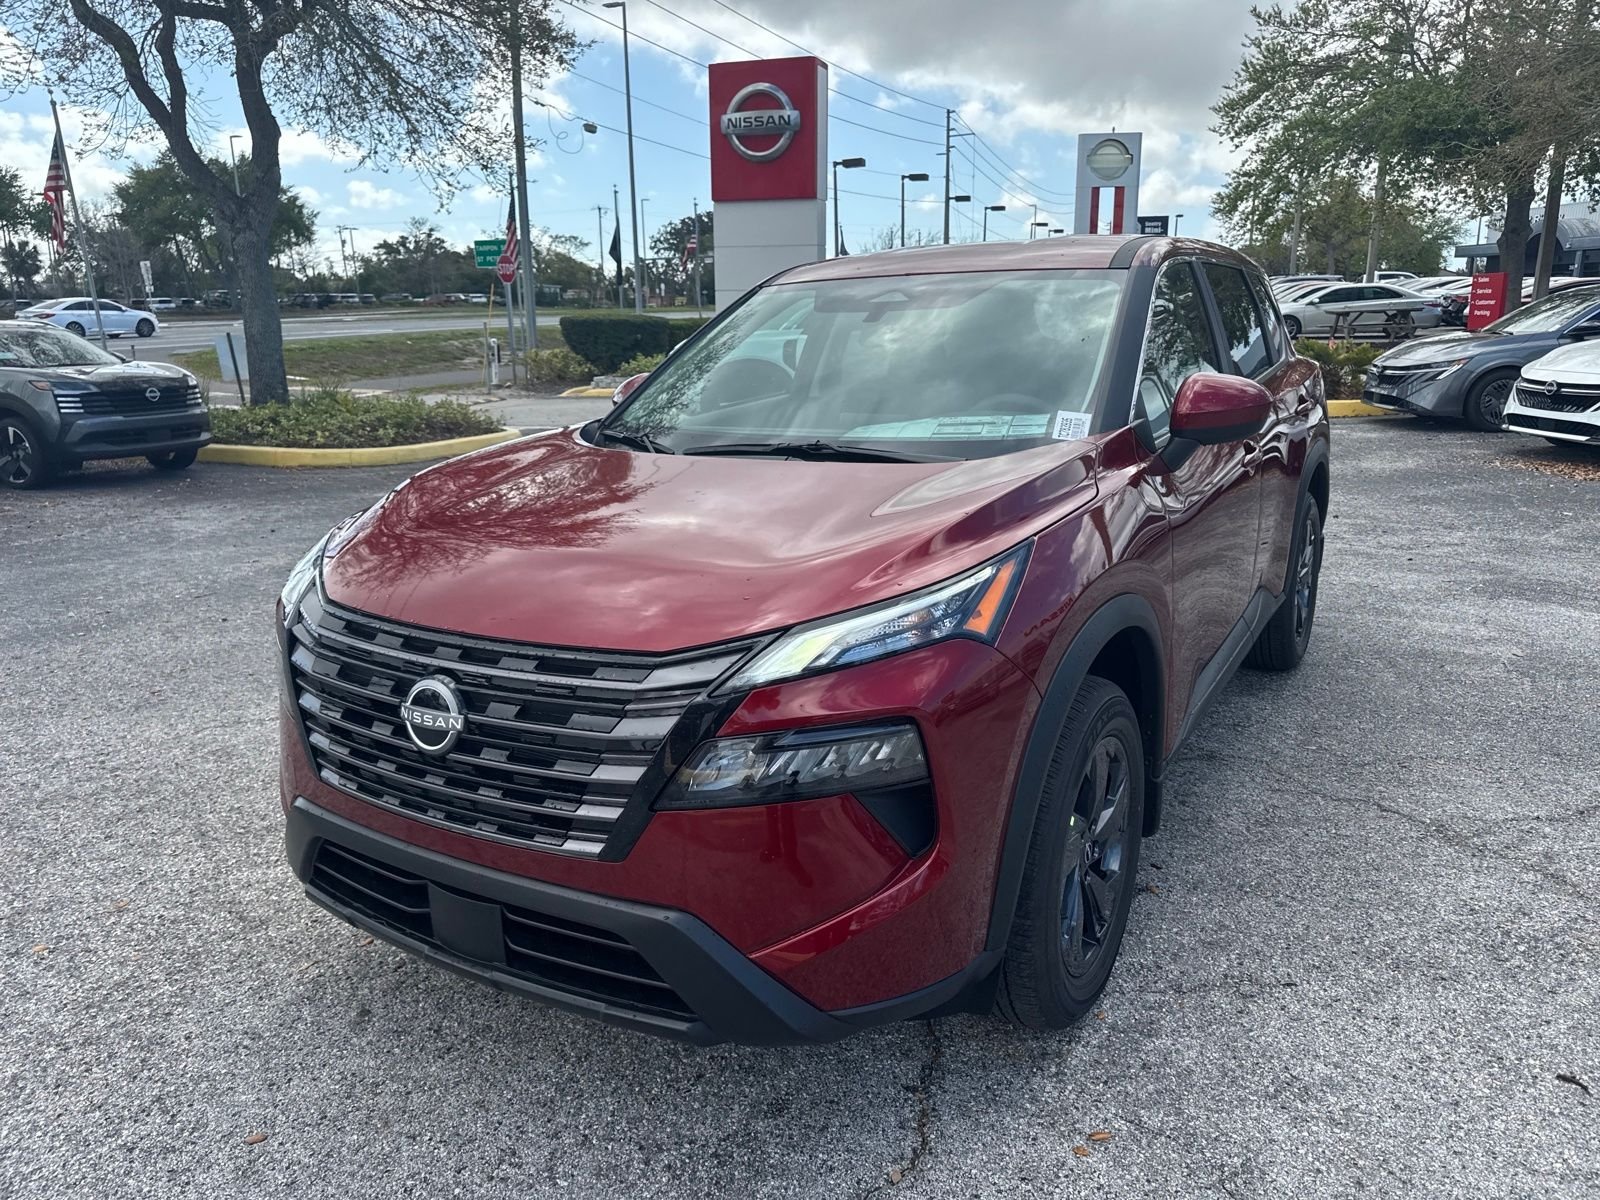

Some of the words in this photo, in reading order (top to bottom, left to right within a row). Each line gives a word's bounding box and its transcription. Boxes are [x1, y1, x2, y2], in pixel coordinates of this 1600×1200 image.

[726, 114, 791, 130] NISSAN
[498, 263, 515, 275] STOP
[401, 706, 462, 729] NISSAN
